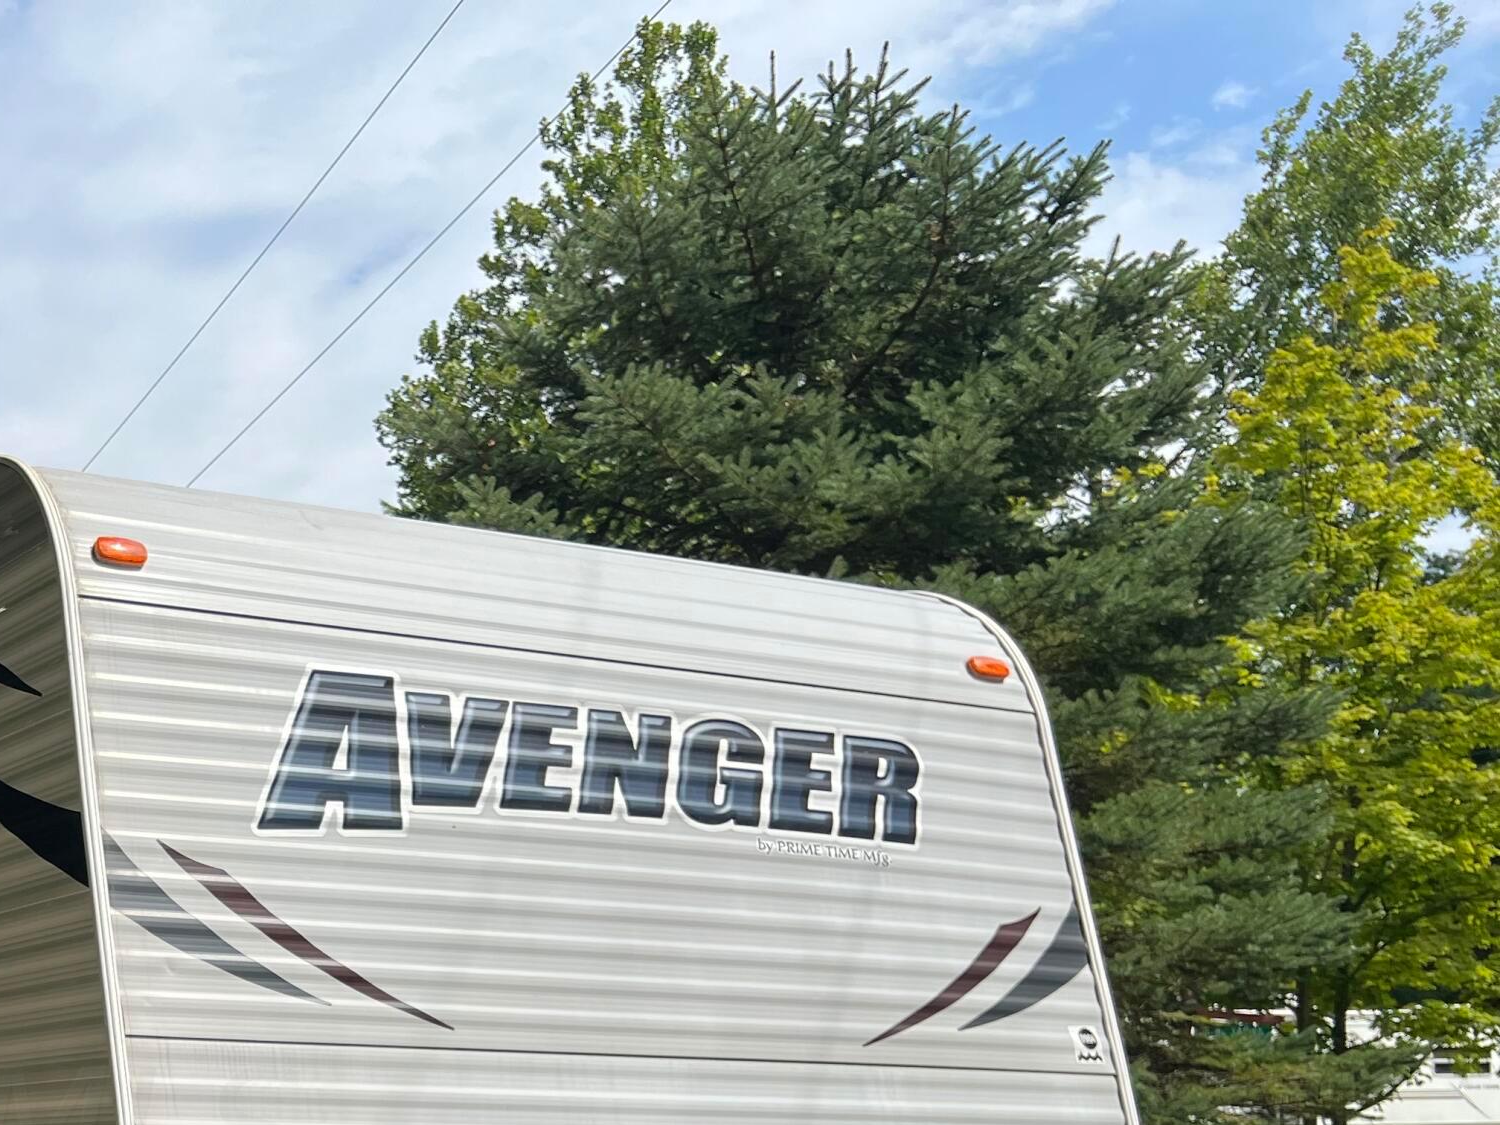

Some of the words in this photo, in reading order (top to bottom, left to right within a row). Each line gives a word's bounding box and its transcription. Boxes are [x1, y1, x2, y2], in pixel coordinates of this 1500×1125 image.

[254, 667, 919, 847] AVENGER
[757, 837, 773, 855] by
[777, 840, 822, 857] PRIME
[825, 845, 860, 860] TIME
[863, 850, 893, 868] Mfg.
